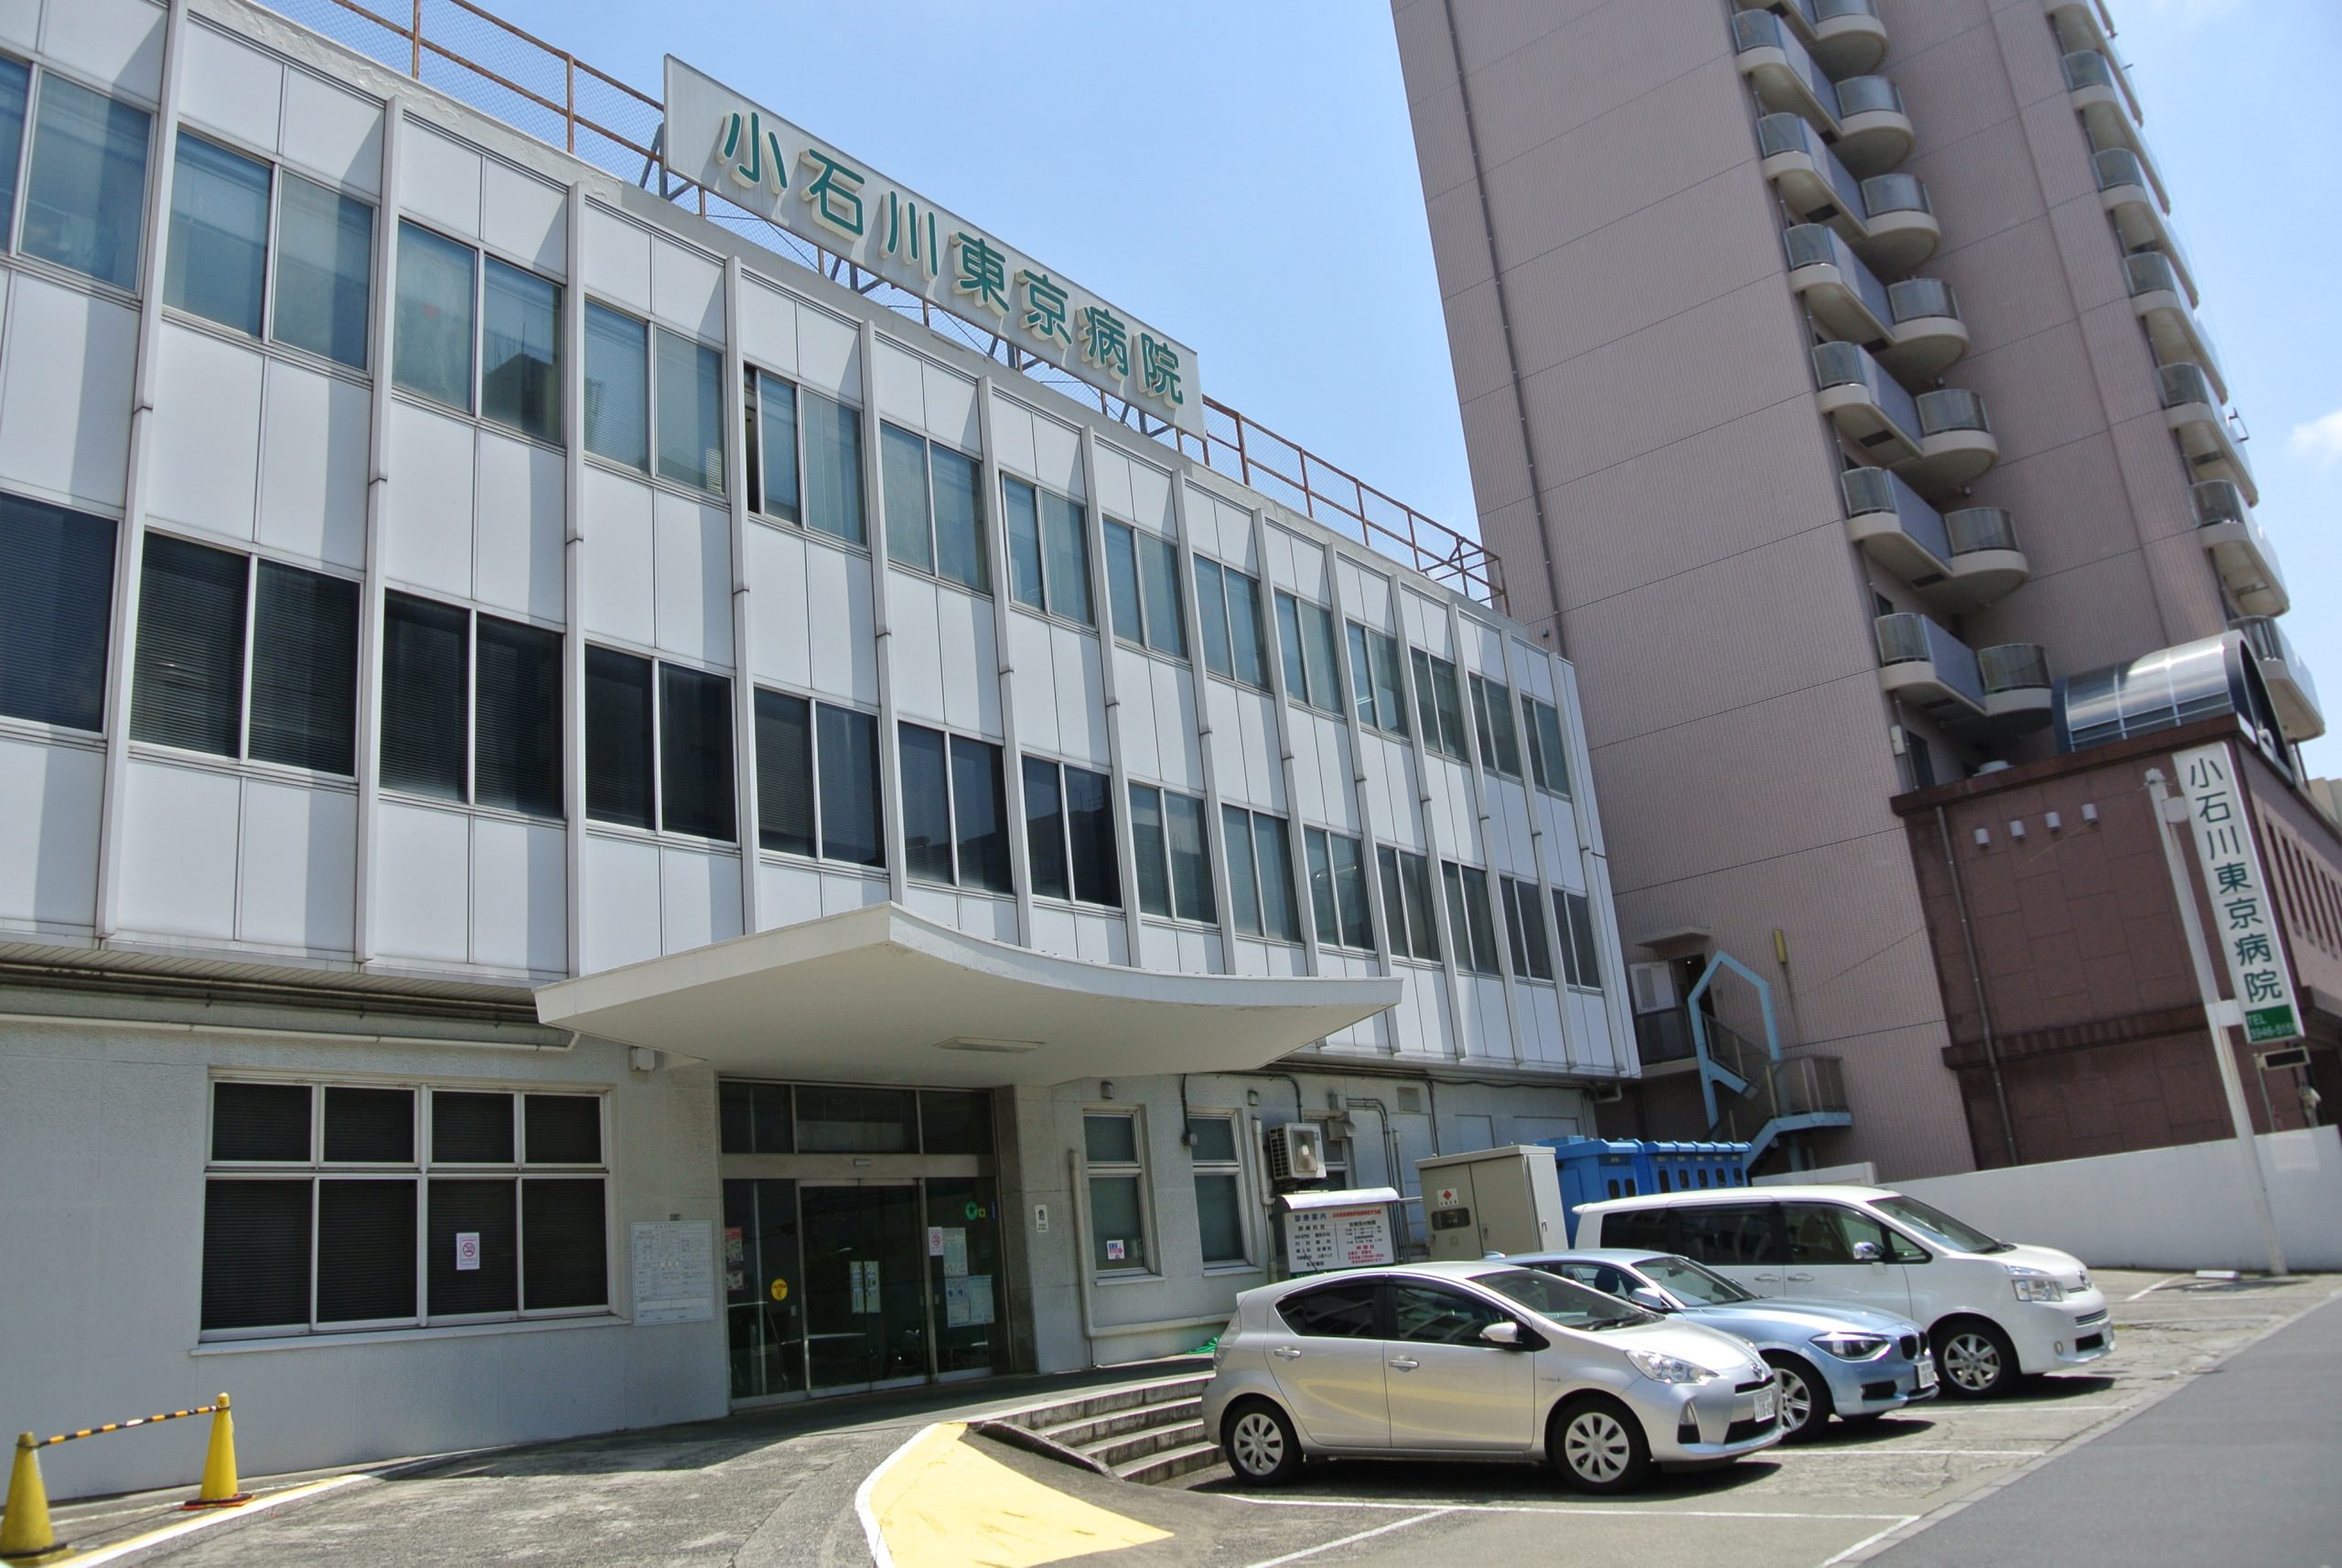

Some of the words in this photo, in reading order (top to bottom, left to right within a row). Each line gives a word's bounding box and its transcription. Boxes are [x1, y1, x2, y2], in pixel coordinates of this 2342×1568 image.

[717, 111, 1185, 407] 小石川東京病院
[2189, 757, 2283, 1004] 小石川東京病院
[2247, 1013, 2267, 1026] TEL
